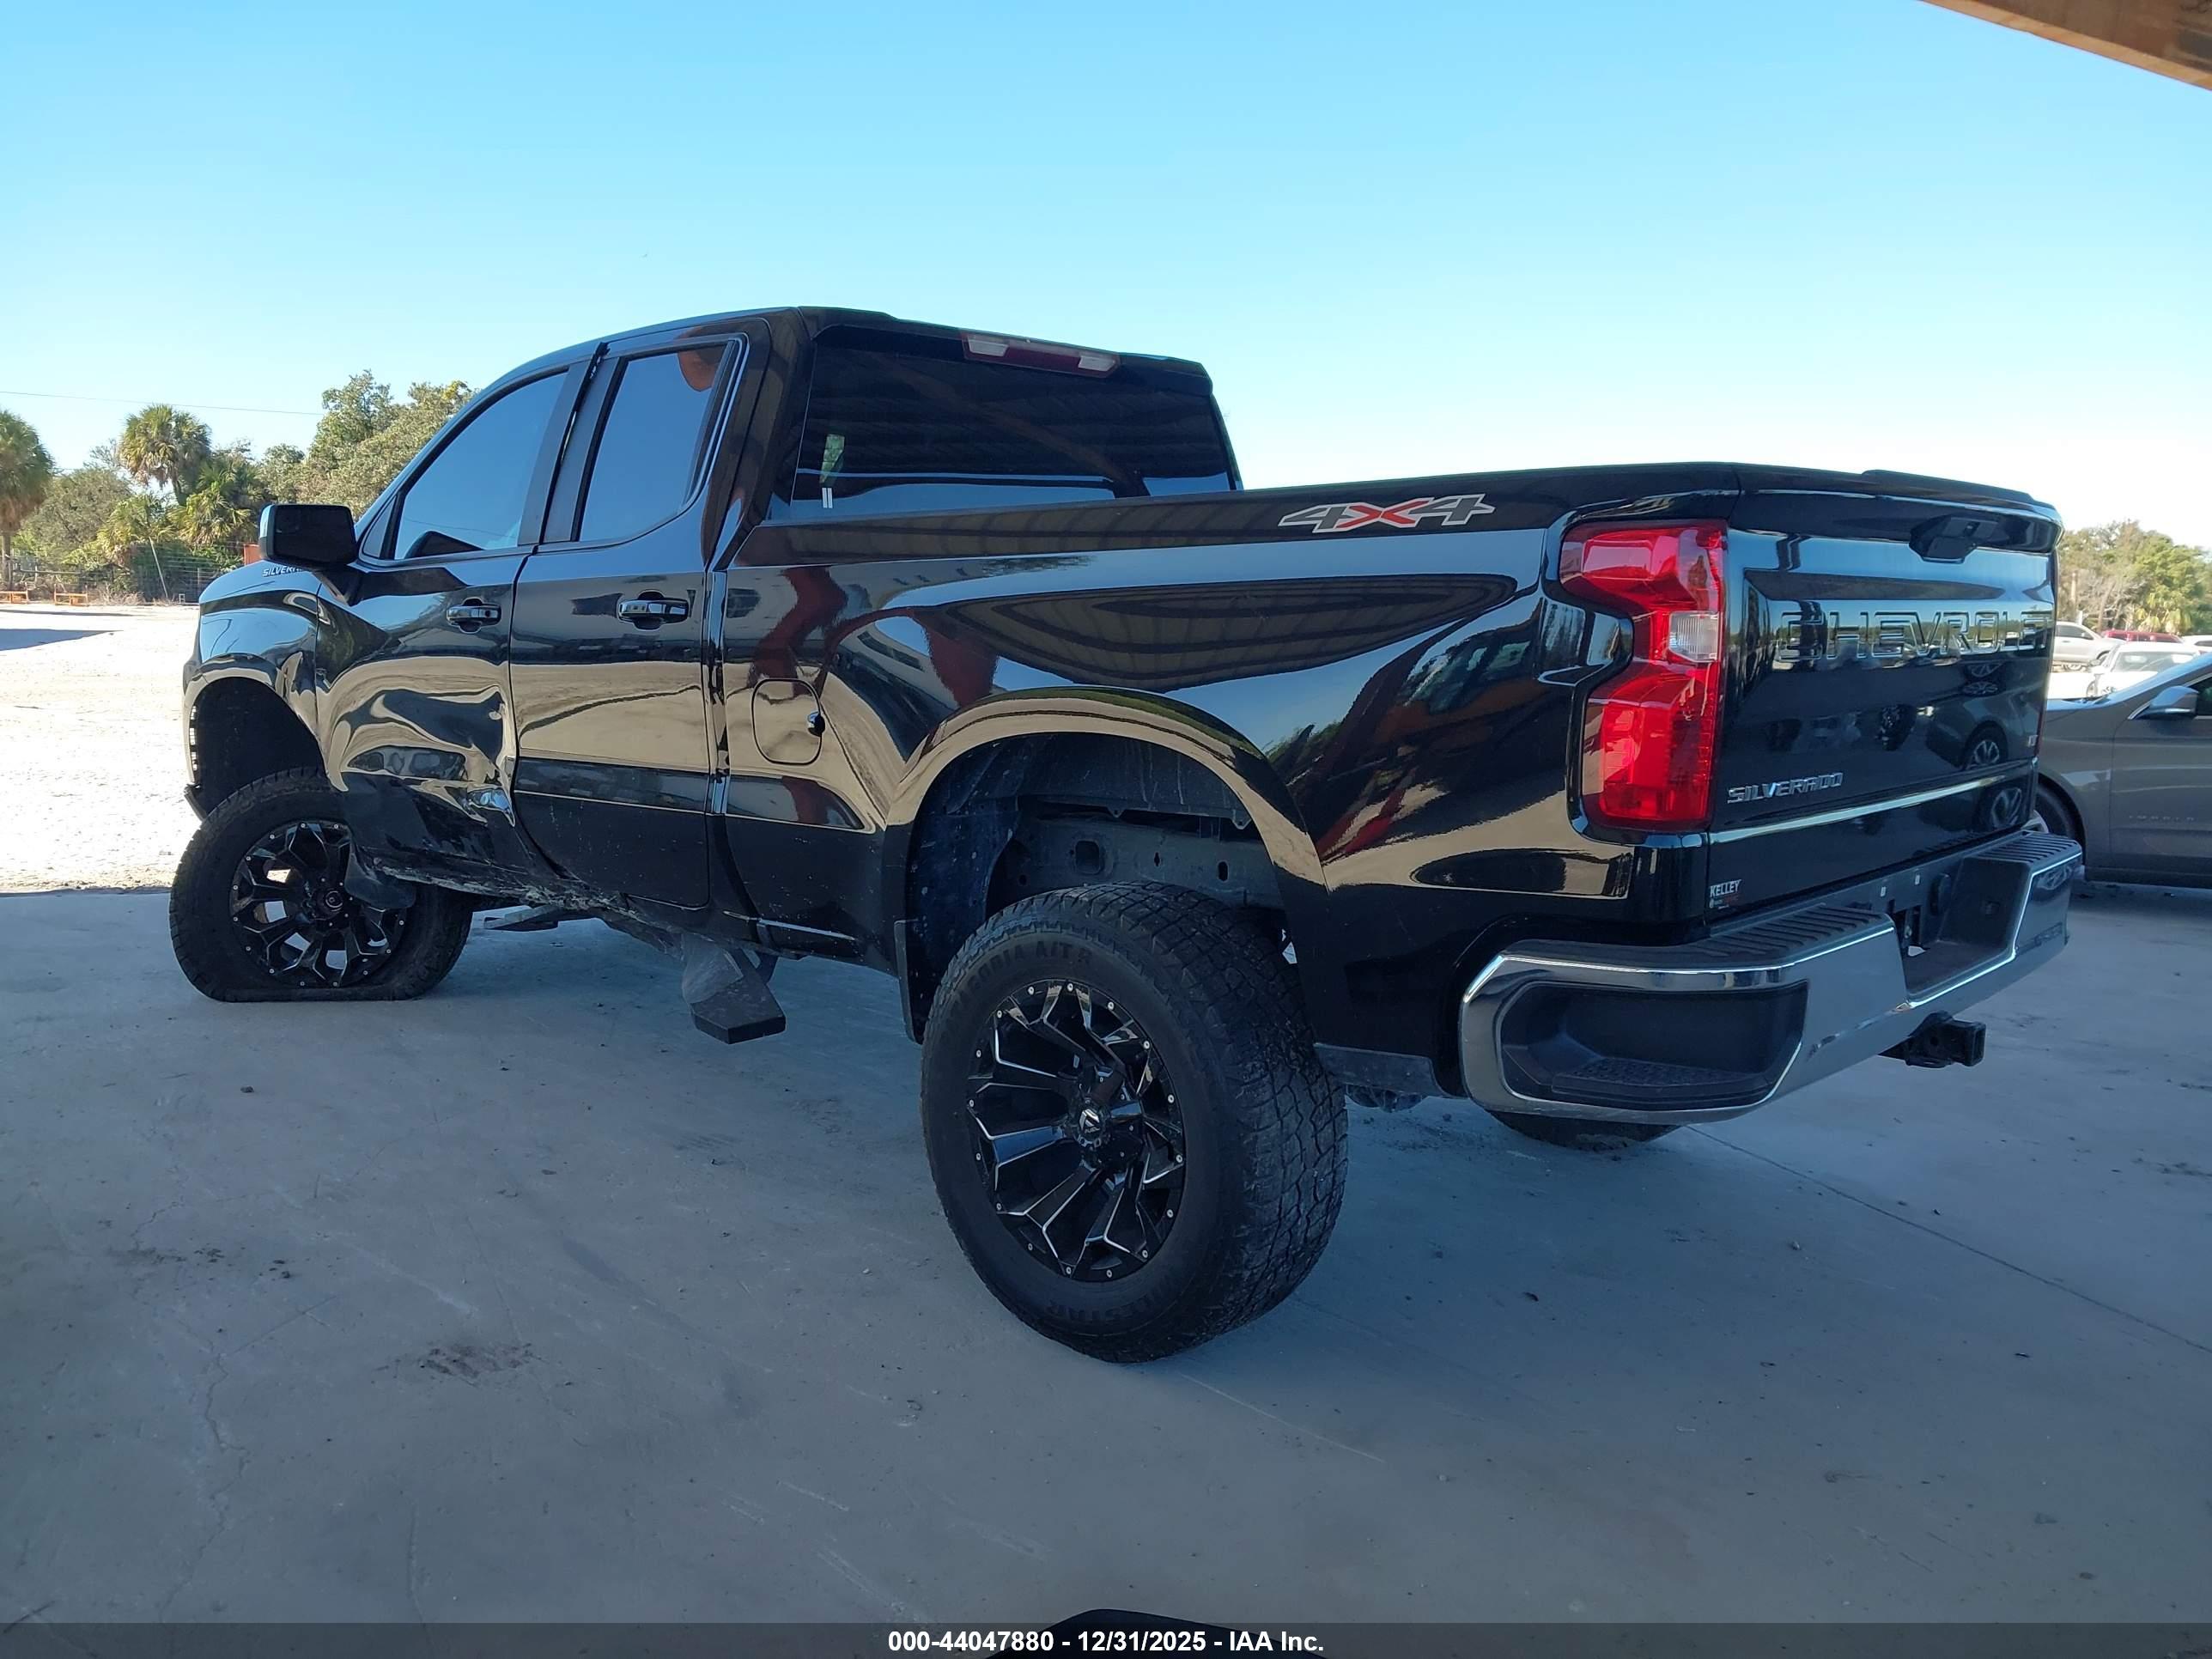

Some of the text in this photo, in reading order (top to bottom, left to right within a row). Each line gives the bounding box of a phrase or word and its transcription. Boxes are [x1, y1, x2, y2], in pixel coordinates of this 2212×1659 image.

[262, 565, 302, 576] SILVER
[1778, 611, 2052, 661] CHEVROLET
[1727, 772, 1844, 804] SILVERADO
[1710, 878, 1742, 898] KELLEY
